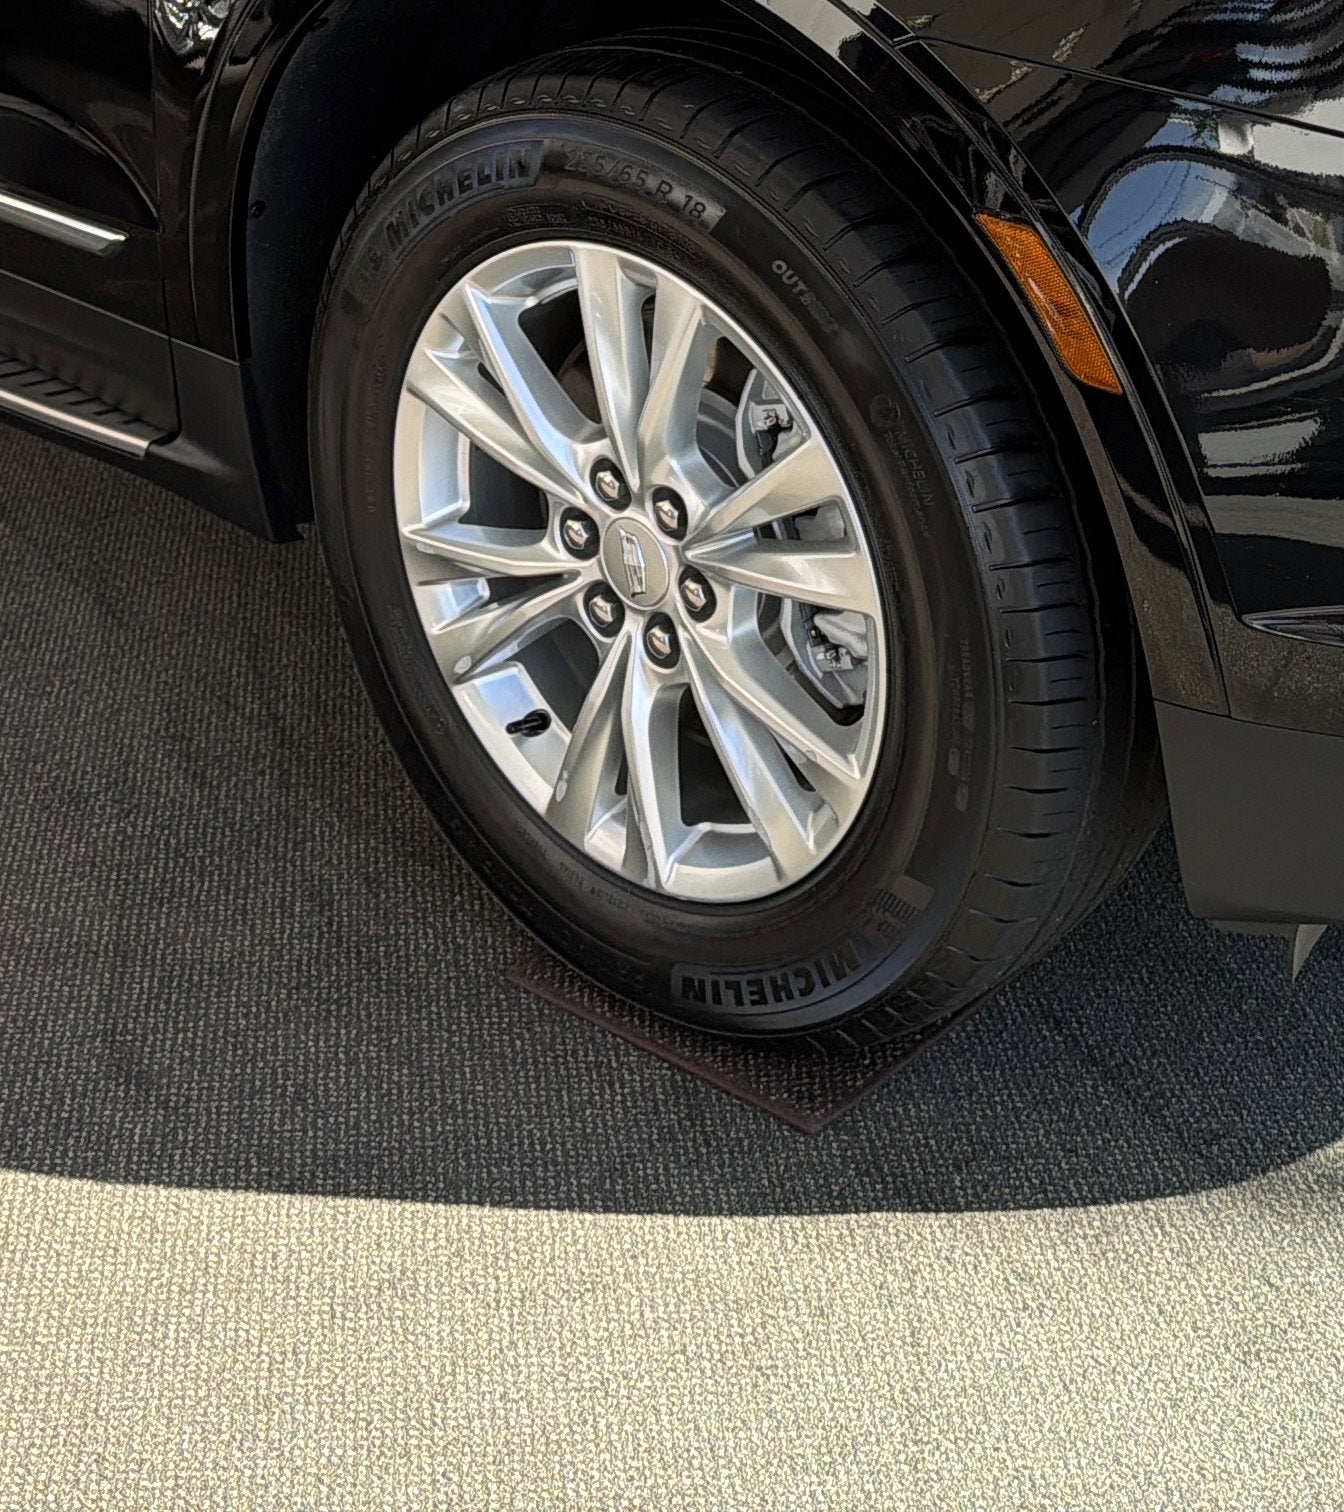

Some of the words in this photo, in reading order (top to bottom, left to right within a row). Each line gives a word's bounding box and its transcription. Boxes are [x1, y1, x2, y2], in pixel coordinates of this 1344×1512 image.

[384, 145, 533, 251] MICHELIN
[655, 178, 673, 203] R
[682, 194, 707, 221] 18
[680, 938, 862, 1008] MICHELIN
